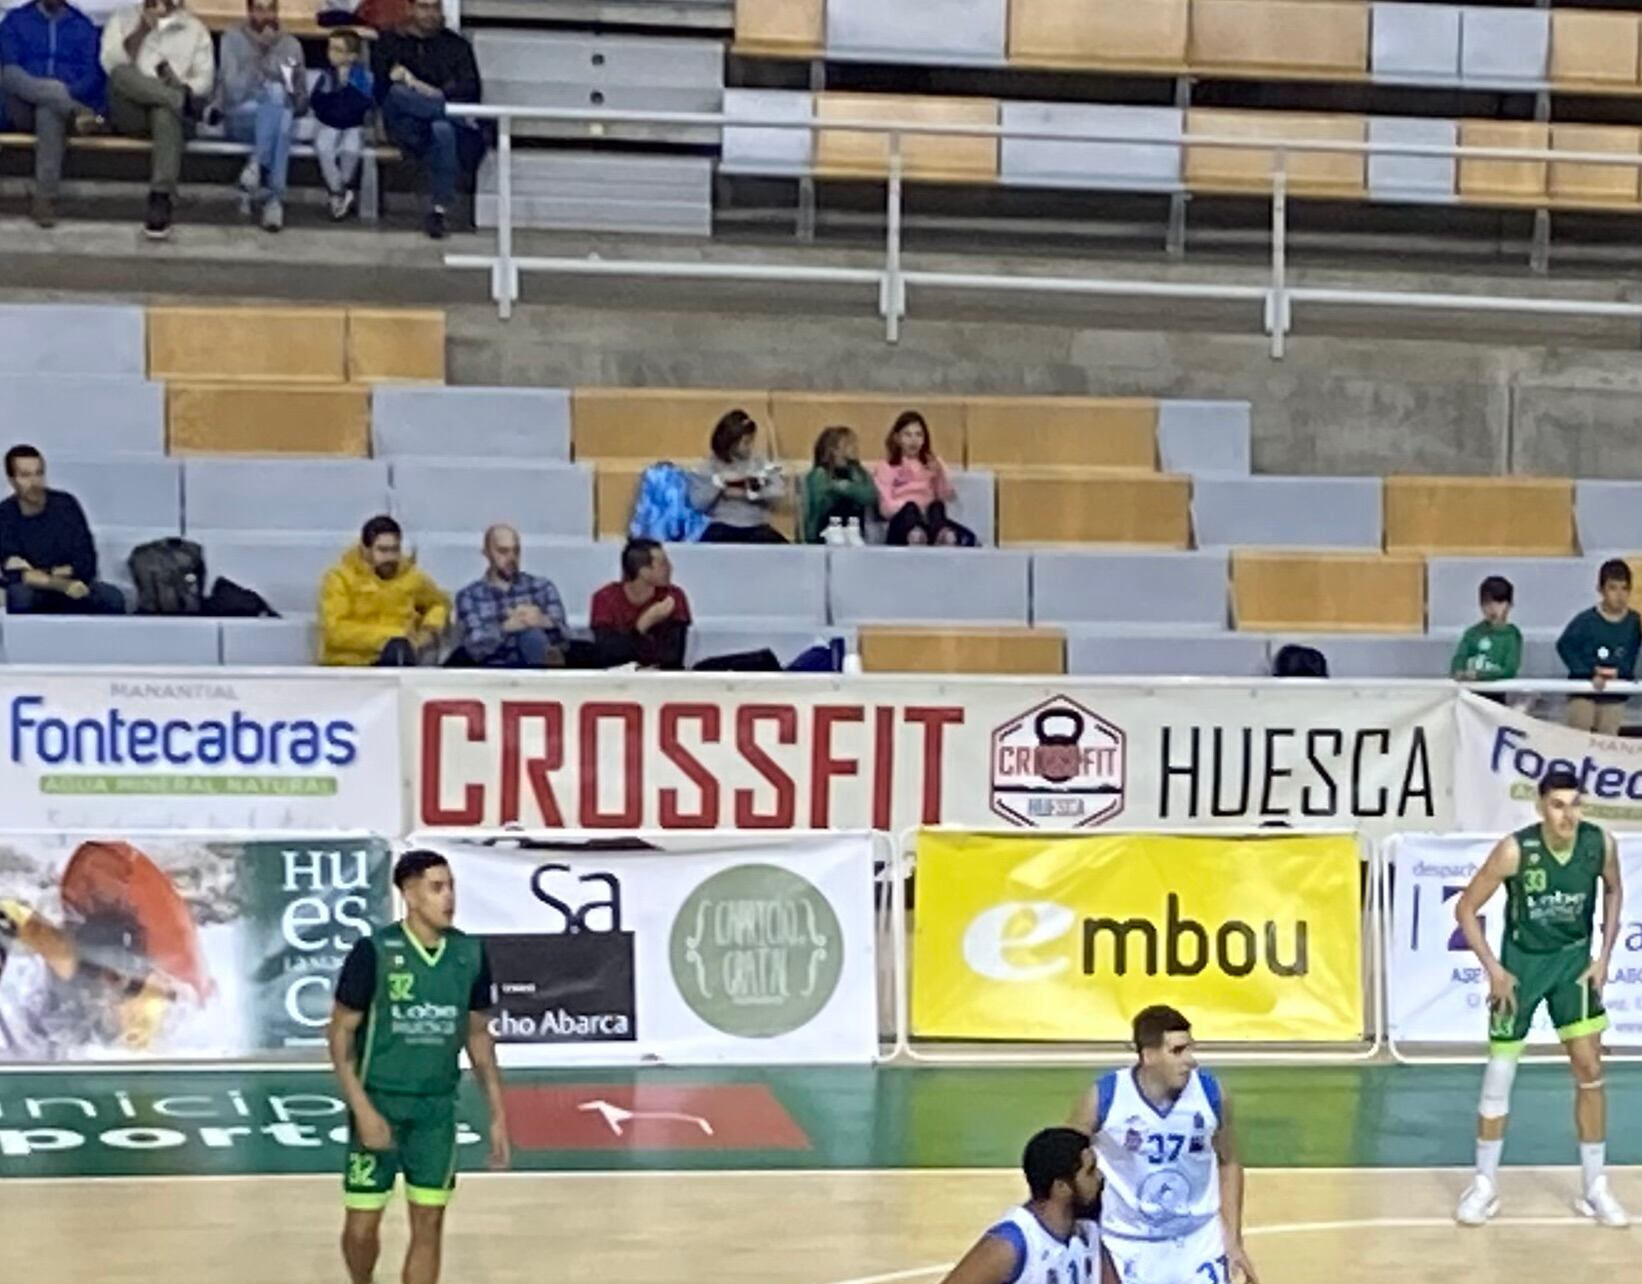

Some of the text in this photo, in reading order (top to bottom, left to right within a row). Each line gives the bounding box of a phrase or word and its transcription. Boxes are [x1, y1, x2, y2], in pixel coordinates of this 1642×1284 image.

[10, 695, 357, 766] Fontecabras
[421, 700, 1435, 830] CROSSFIT HUESCA
[1412, 861, 1480, 878] despach
[487, 1008, 629, 1036] cho Abarca
[1147, 1132, 1186, 1165] 37
[346, 1151, 378, 1187] 32
